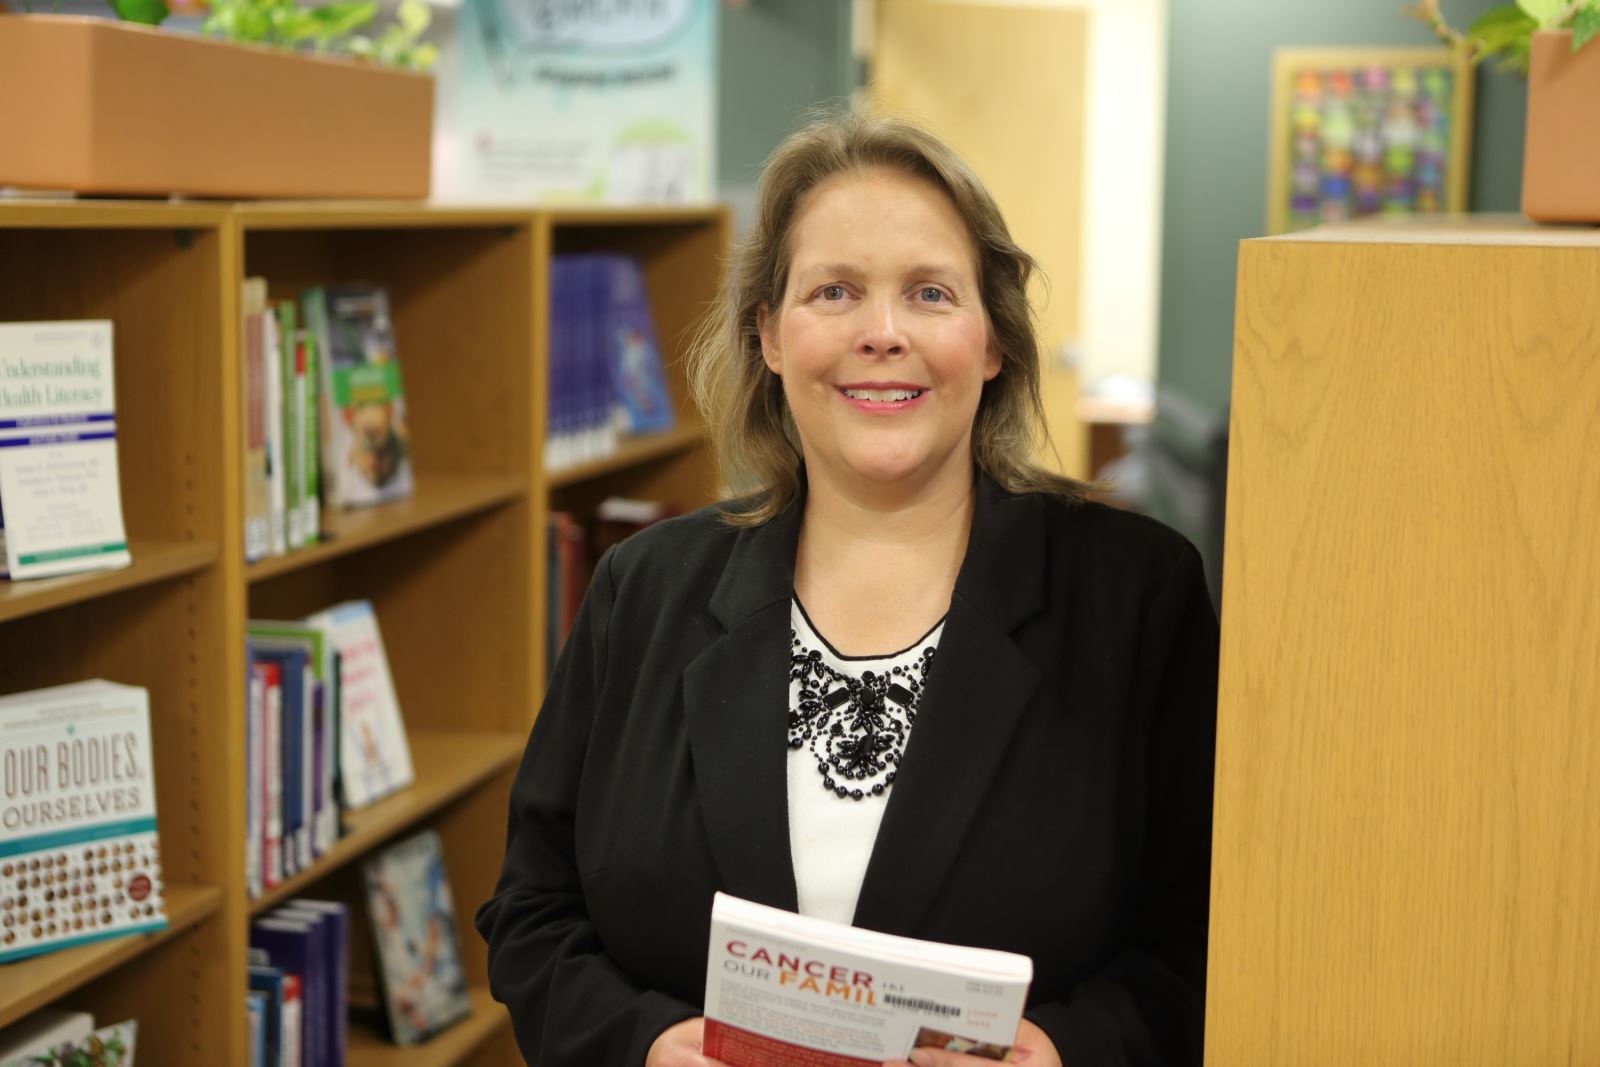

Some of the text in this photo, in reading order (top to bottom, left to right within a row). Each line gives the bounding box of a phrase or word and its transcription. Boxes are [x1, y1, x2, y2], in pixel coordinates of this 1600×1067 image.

[45, 384, 103, 408] Literacy
[4, 743, 49, 798] OUR
[2, 786, 140, 831] OURSELVES
[723, 959, 877, 1006] OUR FAMIL
[726, 940, 874, 990] CANCER
